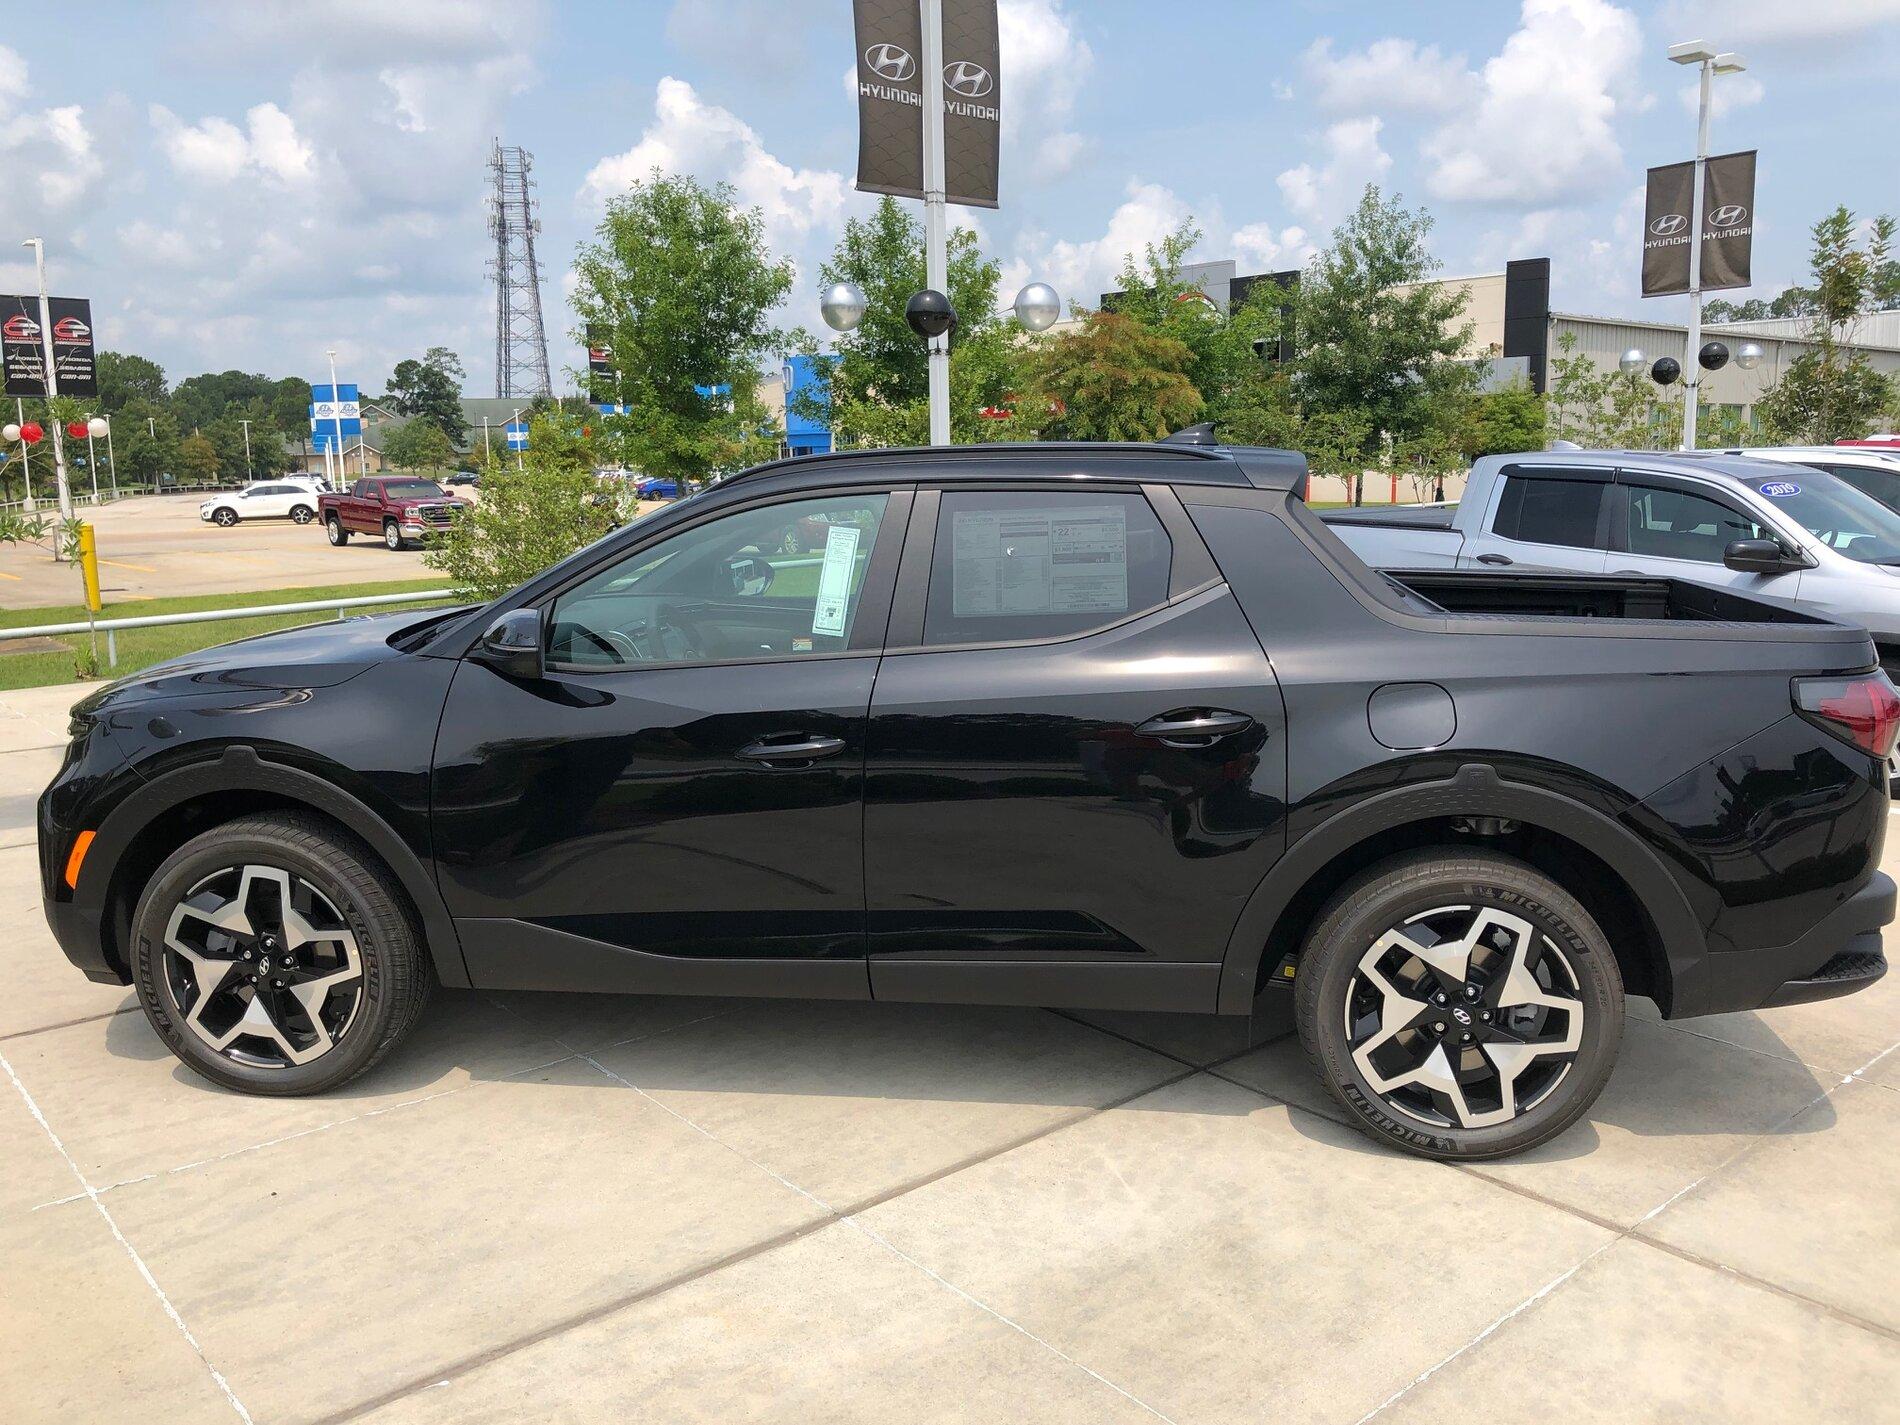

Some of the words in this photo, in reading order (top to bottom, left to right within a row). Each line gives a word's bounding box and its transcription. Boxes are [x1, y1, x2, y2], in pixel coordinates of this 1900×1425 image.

[860, 82, 921, 108] HYUNDAI
[1644, 235, 1691, 250] HYUNDAI
[1702, 227, 1751, 241] HYUNDAI
[1766, 483, 1795, 496] 2019
[1499, 890, 1586, 950] MICHELIN
[1346, 1087, 1431, 1146] MICHELIN
